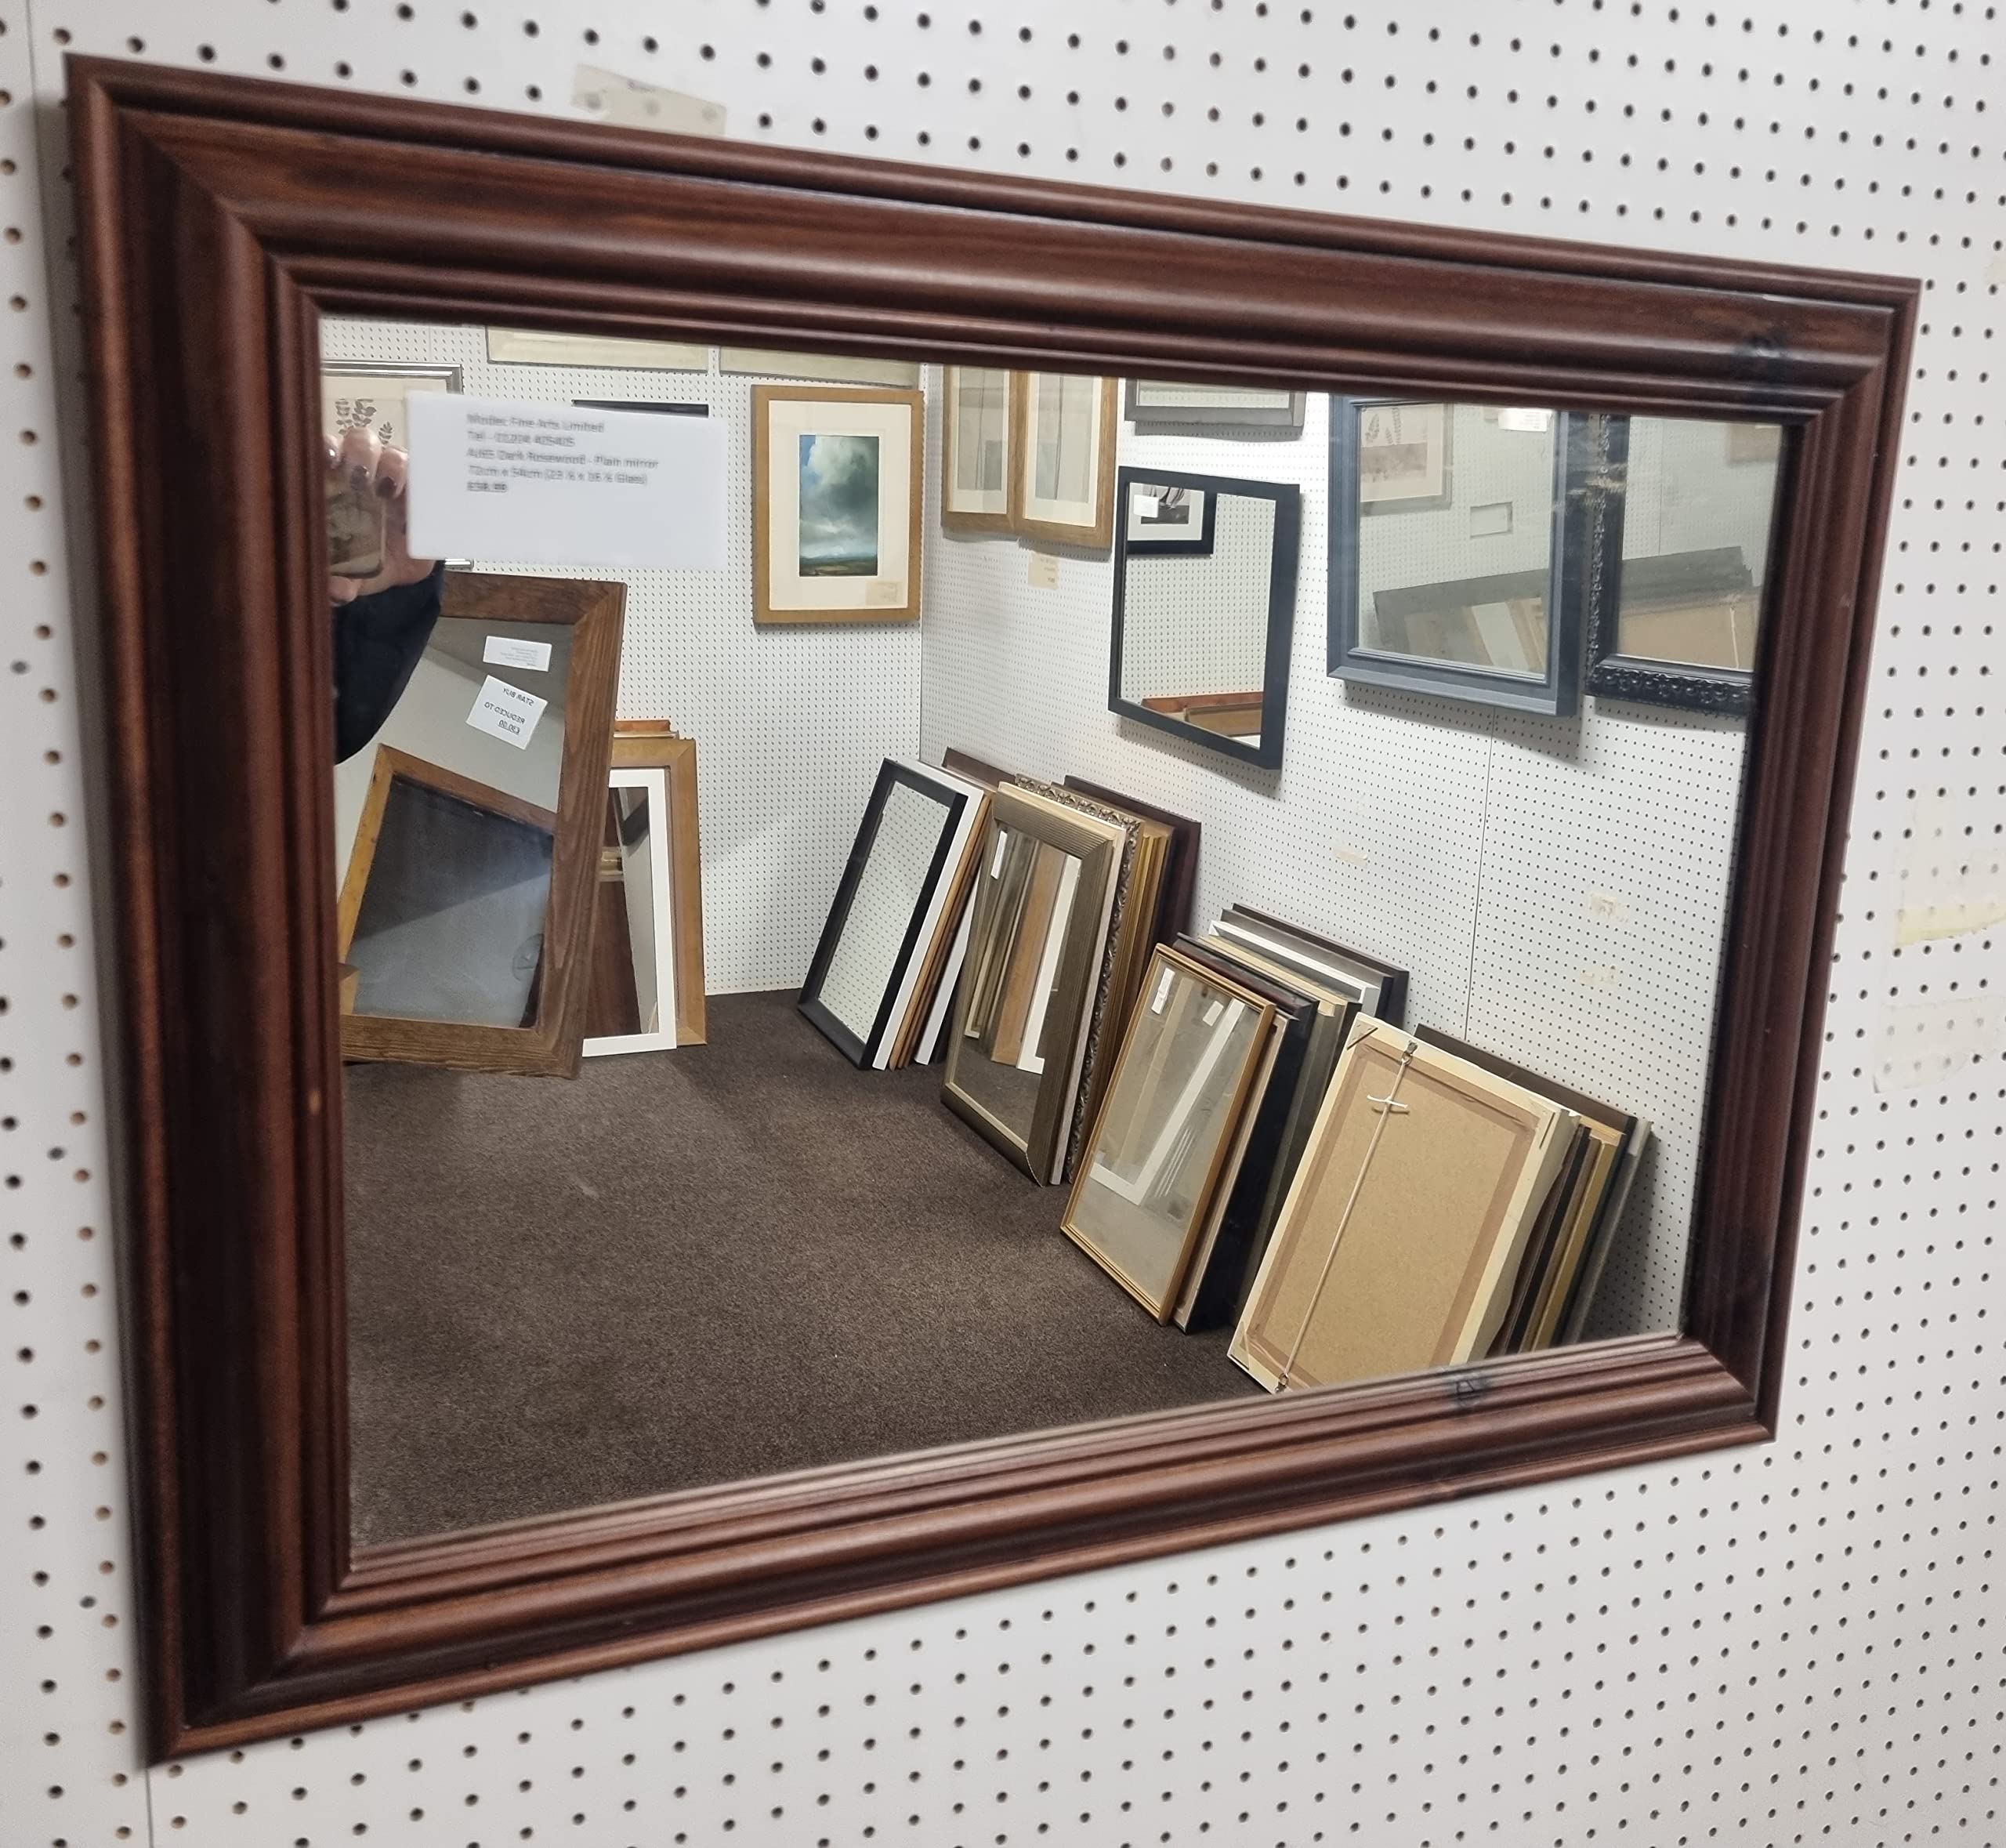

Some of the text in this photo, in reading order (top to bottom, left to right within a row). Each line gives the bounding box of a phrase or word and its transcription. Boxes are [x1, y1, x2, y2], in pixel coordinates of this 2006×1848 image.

[511, 416, 535, 428] Fine
[538, 418, 560, 429] Arts
[564, 420, 606, 433] Limited
[498, 449, 525, 461] Dark
[527, 451, 586, 466] Rosewood
[594, 455, 622, 468] Plain
[625, 458, 660, 469] mirror
